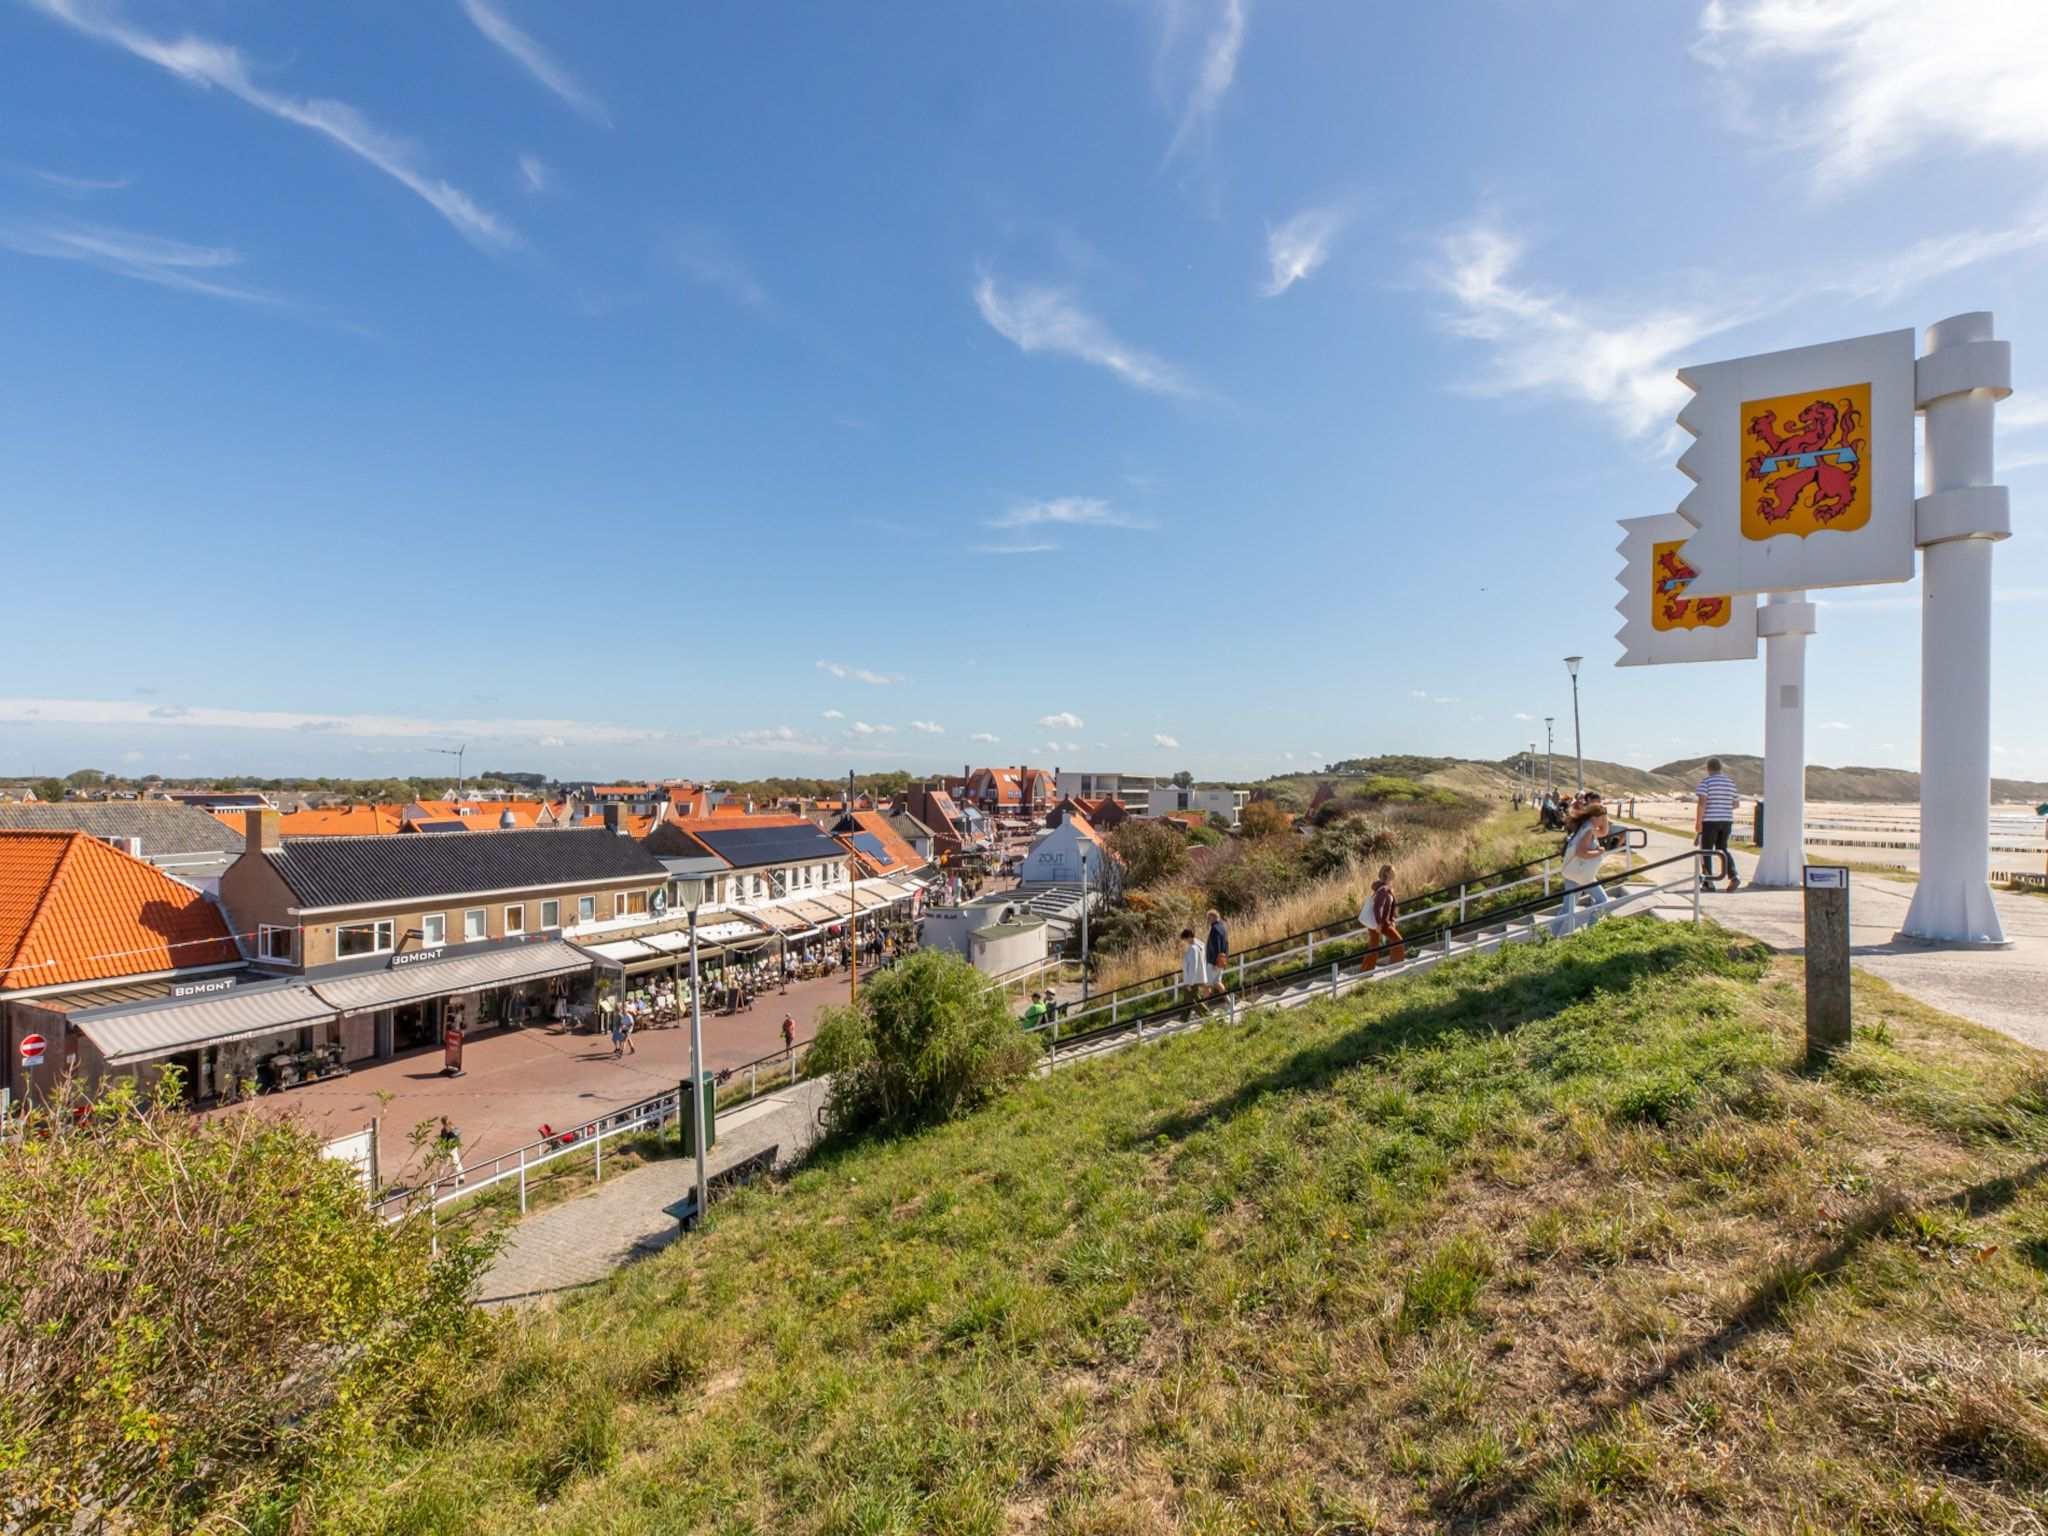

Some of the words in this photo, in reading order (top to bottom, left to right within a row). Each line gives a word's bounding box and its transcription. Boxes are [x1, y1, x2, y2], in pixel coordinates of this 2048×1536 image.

[1038, 853, 1063, 862] ZOUT
[392, 949, 444, 965] BOMONT
[175, 980, 233, 997] BOMONT
